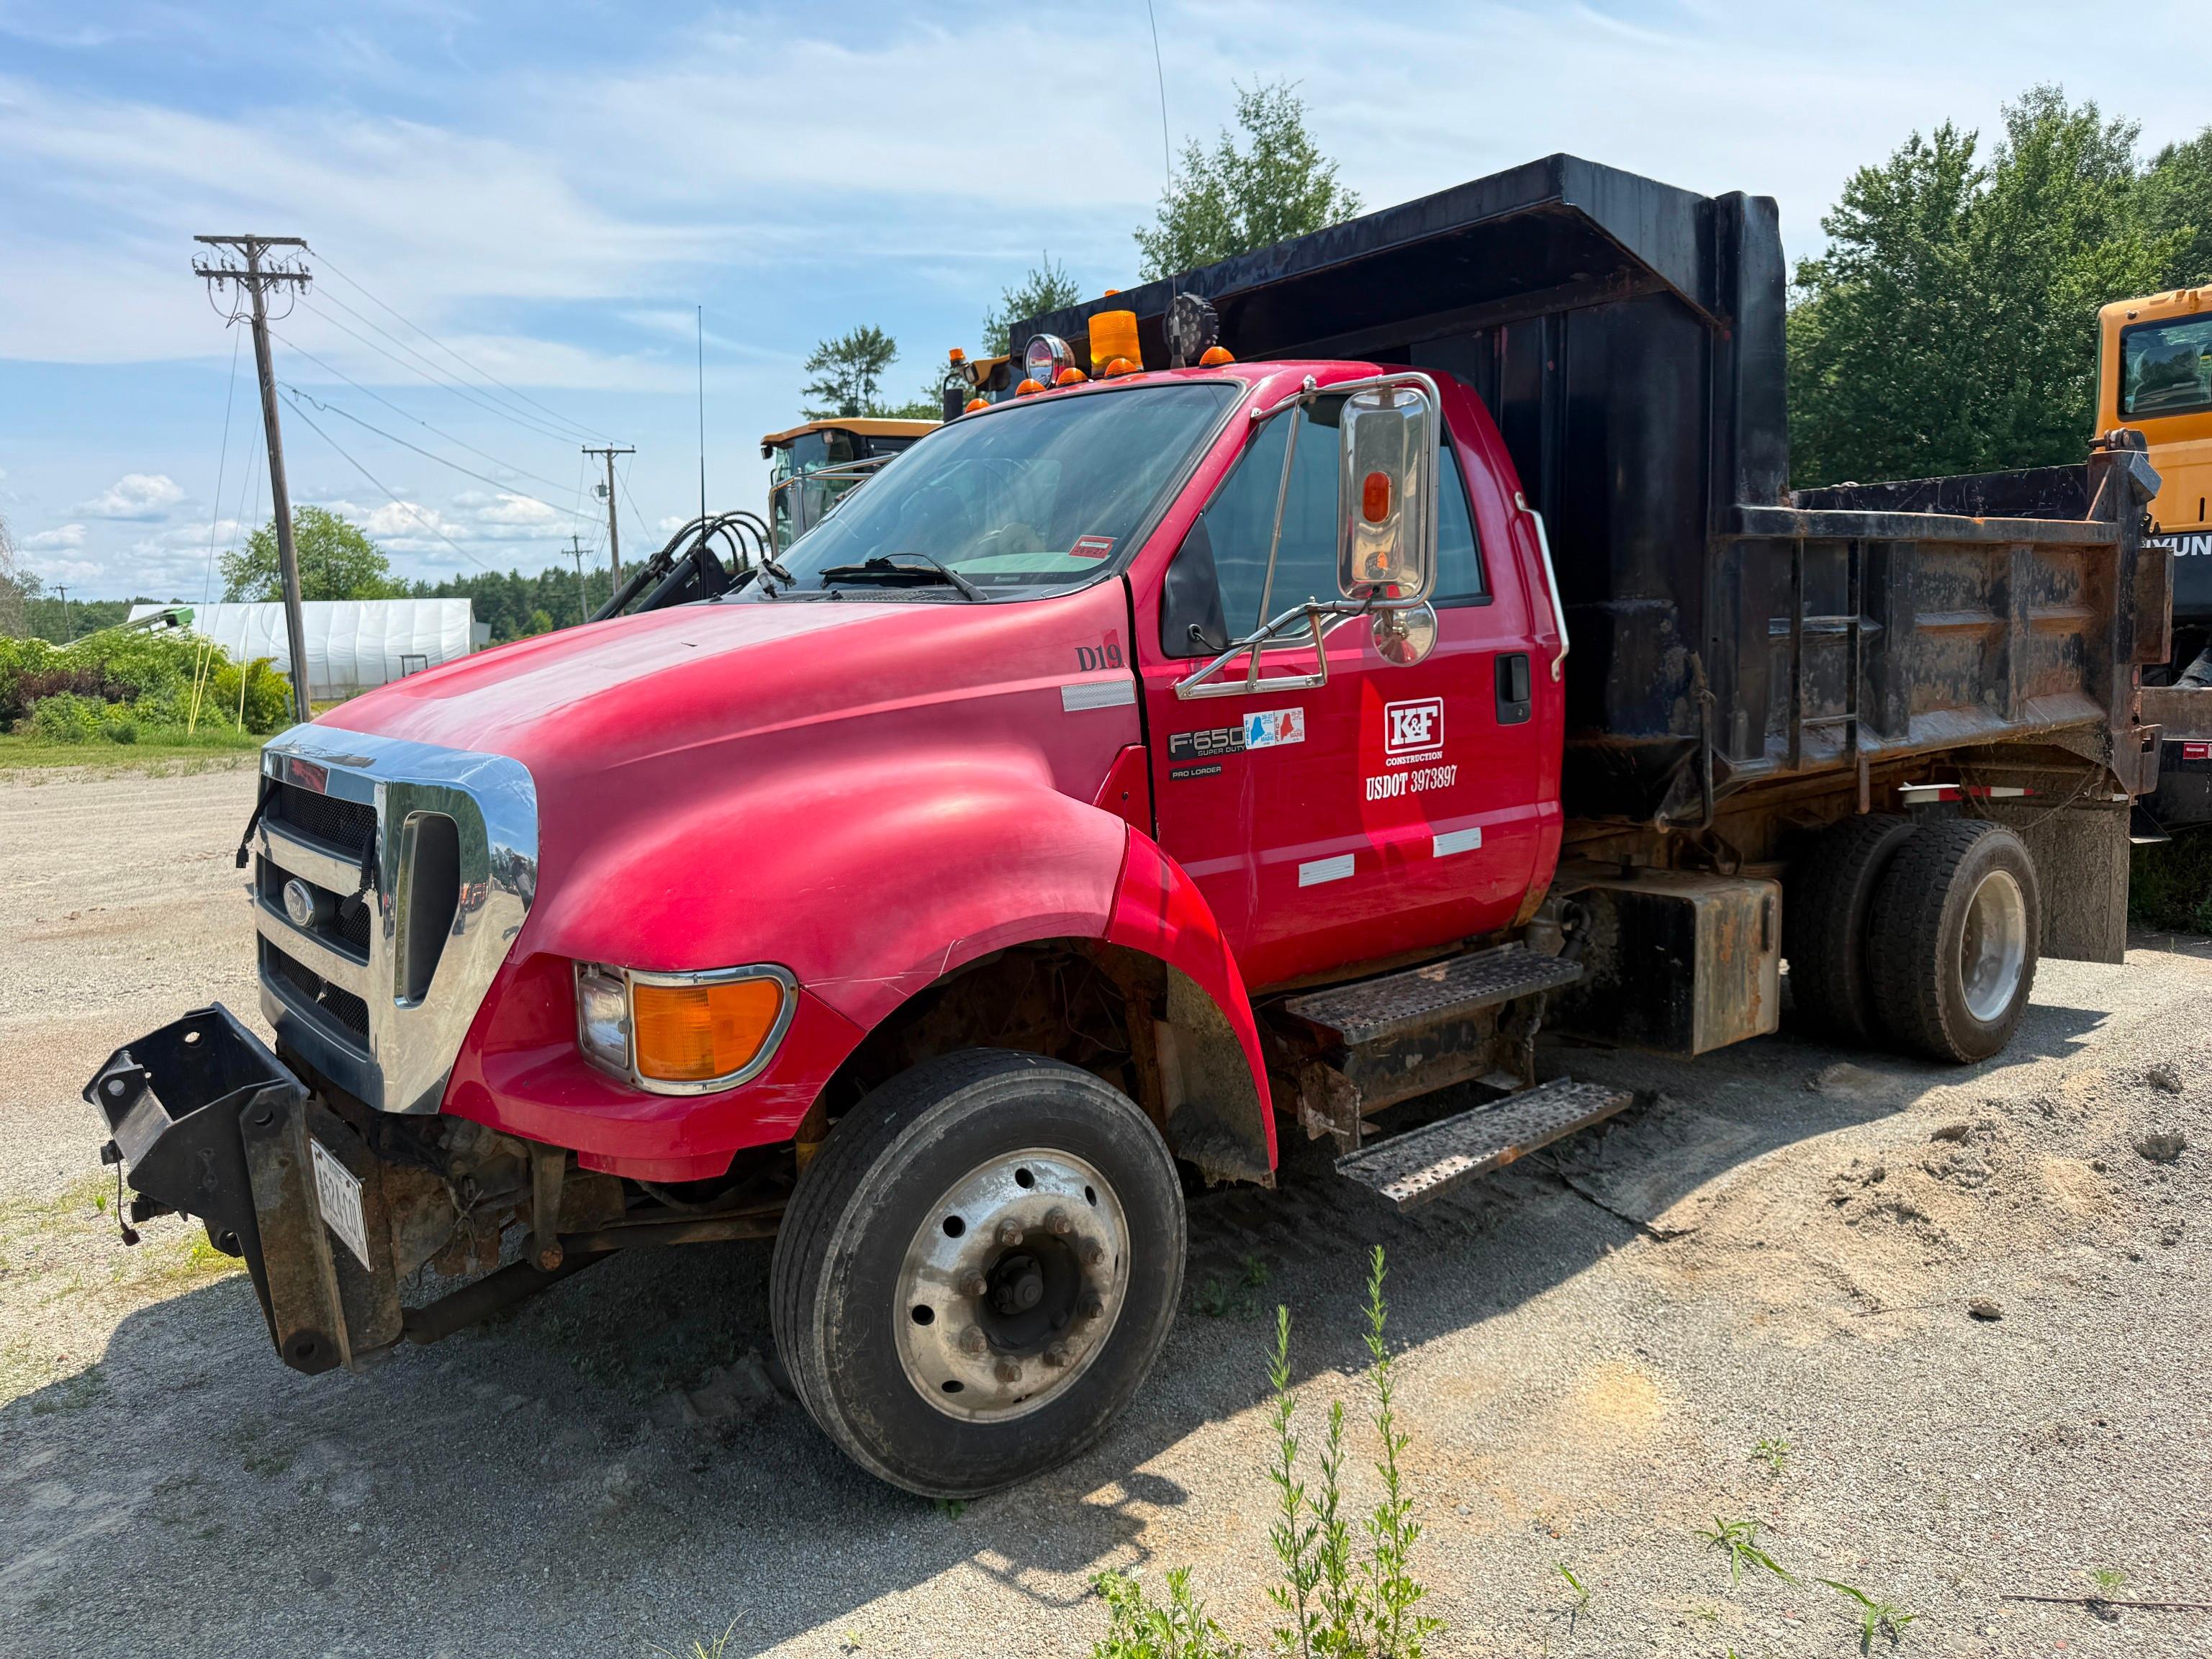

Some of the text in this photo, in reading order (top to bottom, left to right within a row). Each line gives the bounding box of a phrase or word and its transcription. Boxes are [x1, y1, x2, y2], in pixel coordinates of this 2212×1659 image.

[1075, 644, 1122, 672] D19
[1391, 705, 1438, 746] K&F
[1197, 748, 1224, 756] SUPER
[1386, 751, 1443, 767] CONSTRUCTION
[1191, 766, 1222, 776] LOADER
[1365, 764, 1458, 801] USDOT 3973897
